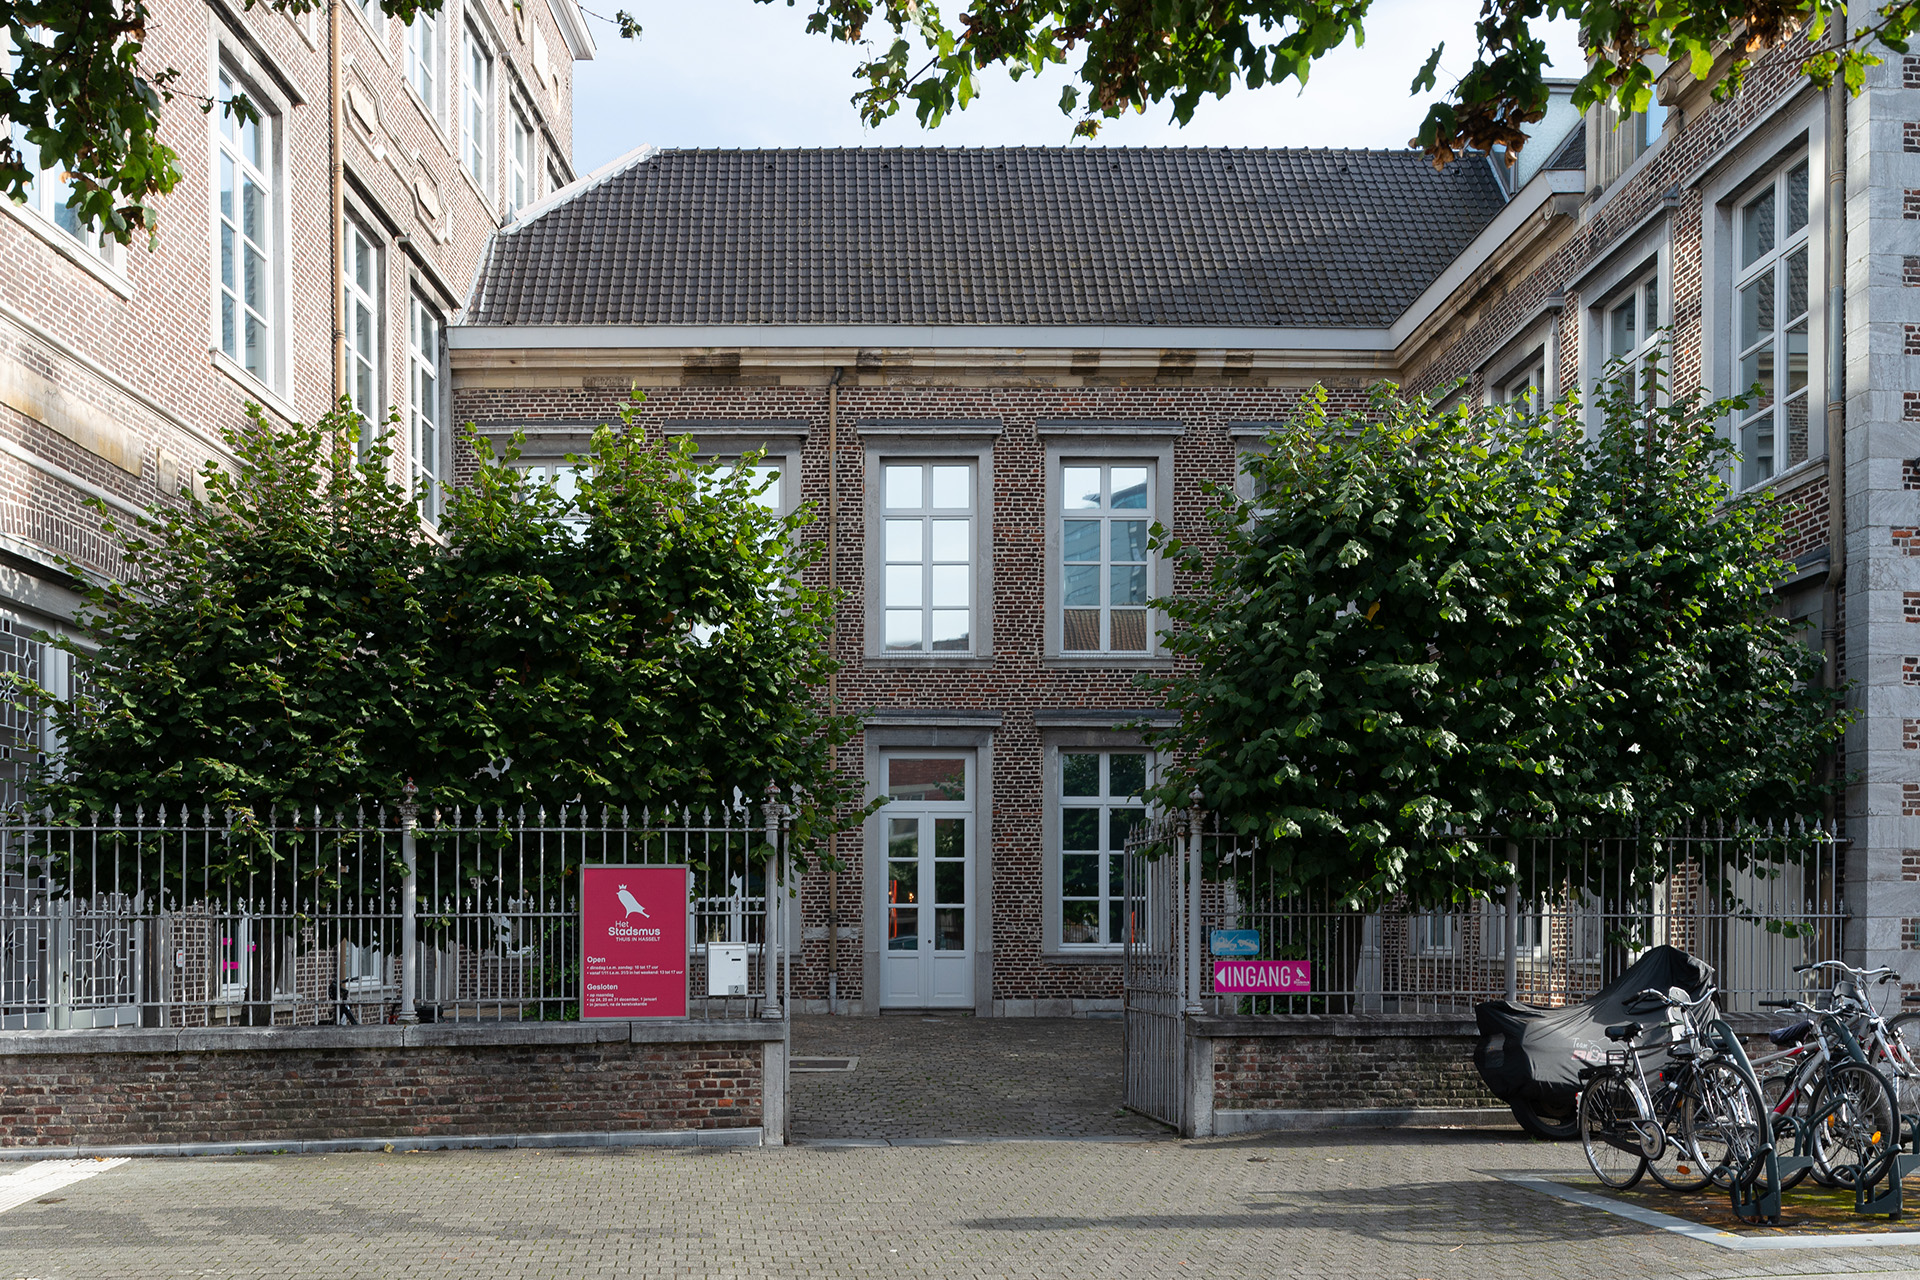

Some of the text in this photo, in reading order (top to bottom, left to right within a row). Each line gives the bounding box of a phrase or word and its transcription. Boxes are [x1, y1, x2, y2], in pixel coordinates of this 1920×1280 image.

[608, 926, 661, 936] Stadsmus
[1228, 966, 1290, 987] INGANG
[1572, 1037, 1588, 1049] Team
